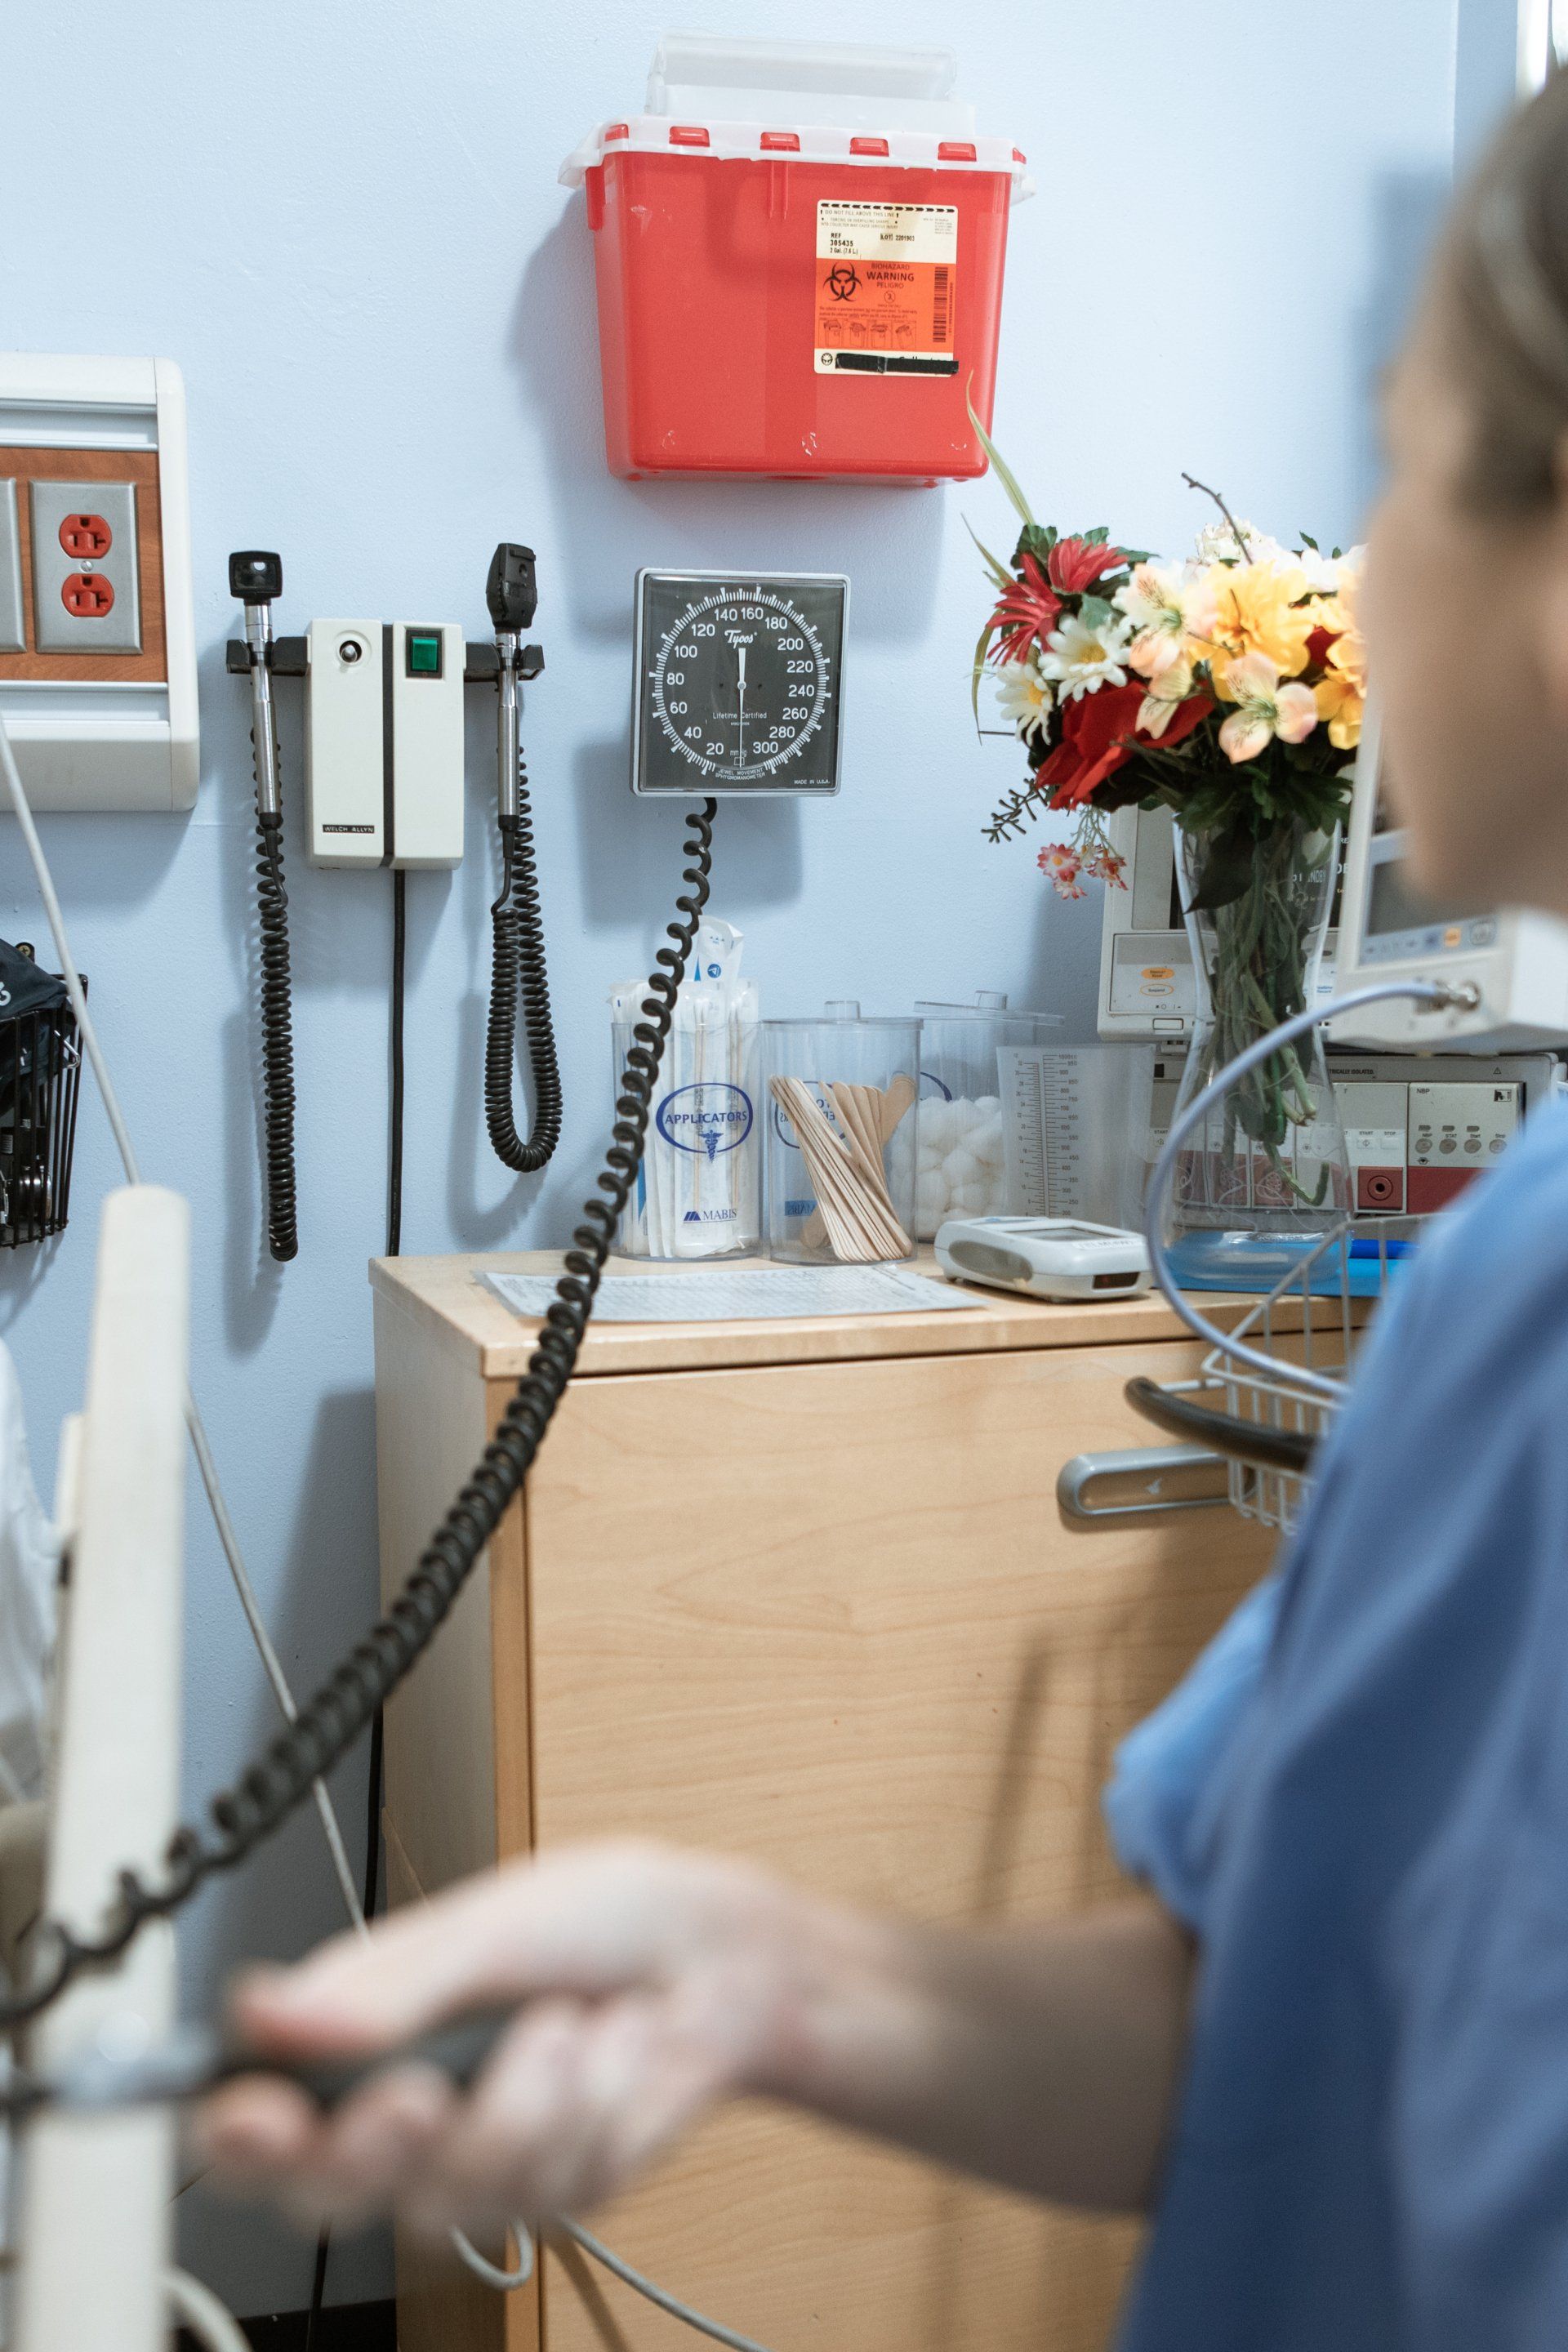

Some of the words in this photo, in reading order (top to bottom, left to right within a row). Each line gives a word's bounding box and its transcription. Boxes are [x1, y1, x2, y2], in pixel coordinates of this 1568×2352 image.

[871, 262, 911, 271] BIOHAZARD
[866, 270, 914, 282] WARNING
[876, 281, 904, 289] PELIGRO
[714, 608, 737, 621] 140
[741, 607, 764, 620] 160
[692, 623, 715, 637] 120
[764, 617, 788, 630] 180
[777, 638, 804, 651] 200
[674, 645, 697, 658] 100
[786, 661, 813, 674] 220
[666, 673, 684, 686] 80
[788, 684, 815, 697] 240
[670, 702, 688, 715] 60
[712, 711, 737, 719] Lifetime
[782, 707, 808, 720] 260
[684, 727, 702, 739] 40
[768, 726, 795, 739] 280
[706, 742, 724, 755] 20
[752, 742, 779, 754] 300
[737, 768, 764, 776] MOVEMENT
[664, 1111, 747, 1125] APPLICATORS
[703, 1209, 737, 1221] MABIS
